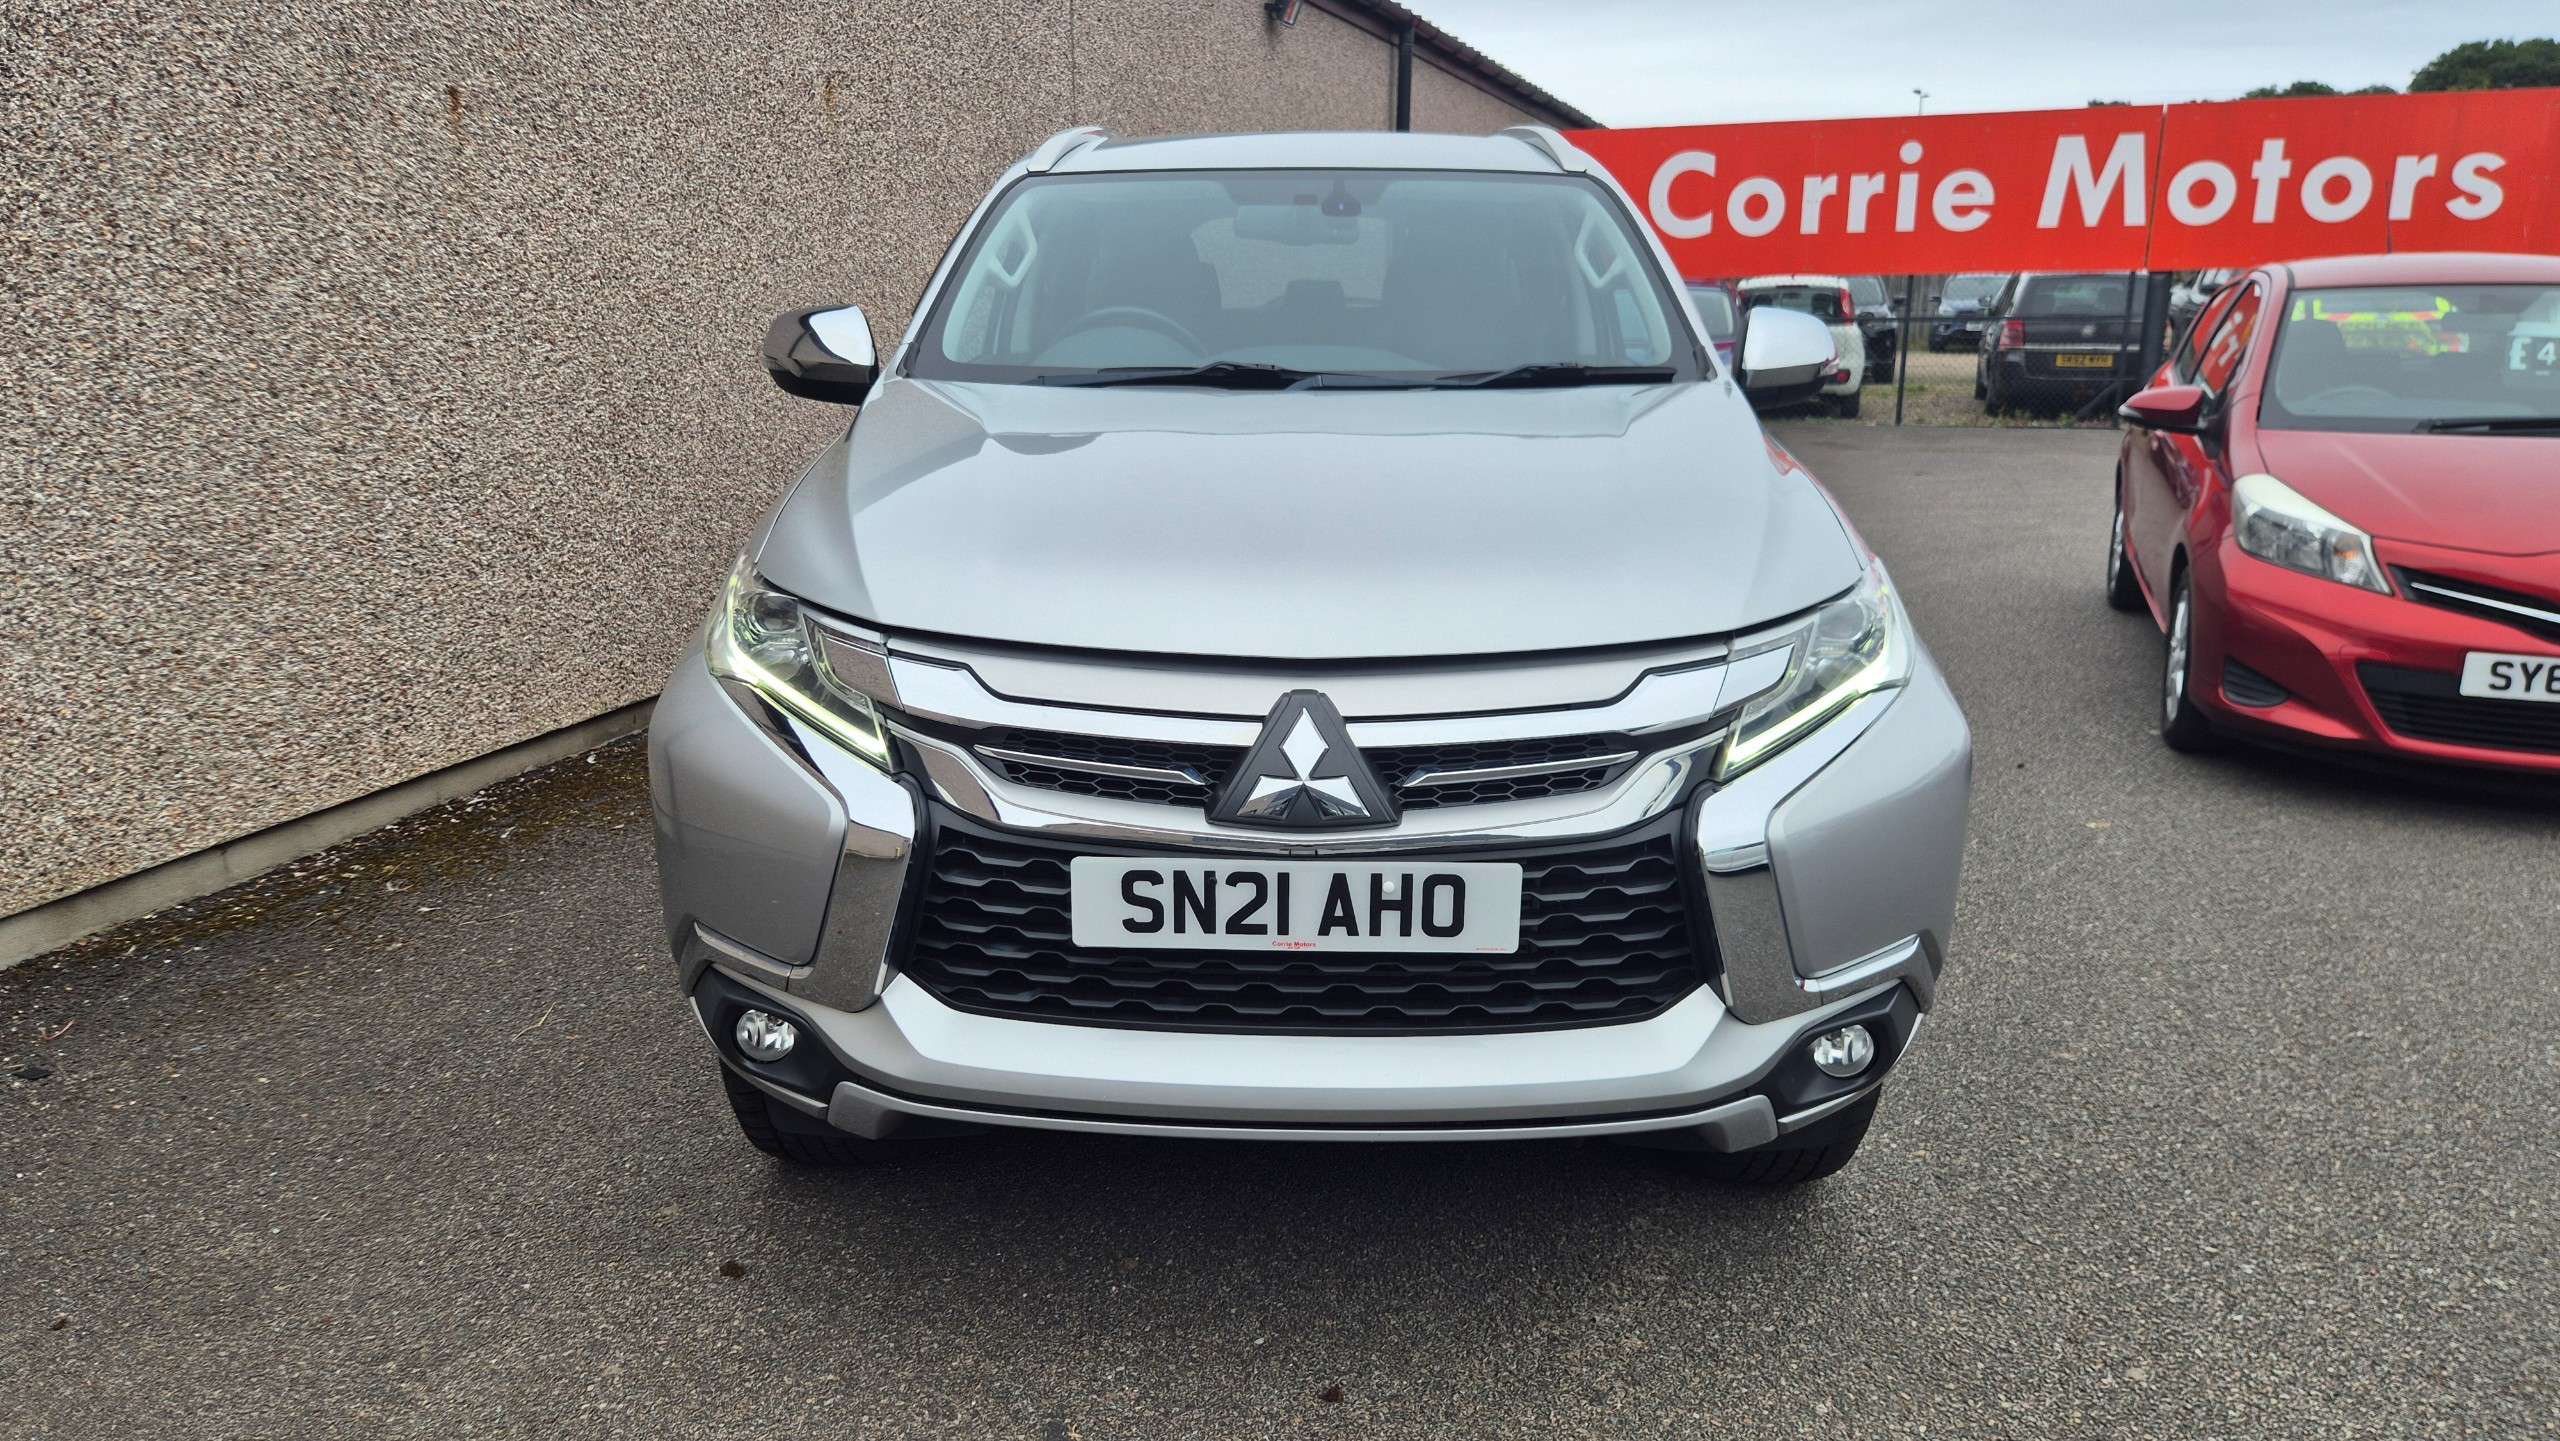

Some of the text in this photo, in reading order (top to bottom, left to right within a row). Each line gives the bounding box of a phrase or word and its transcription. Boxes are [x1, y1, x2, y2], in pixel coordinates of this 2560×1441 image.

[1648, 132, 2506, 239] Corrie Motors
[1121, 869, 1466, 938] SN21 AHO
